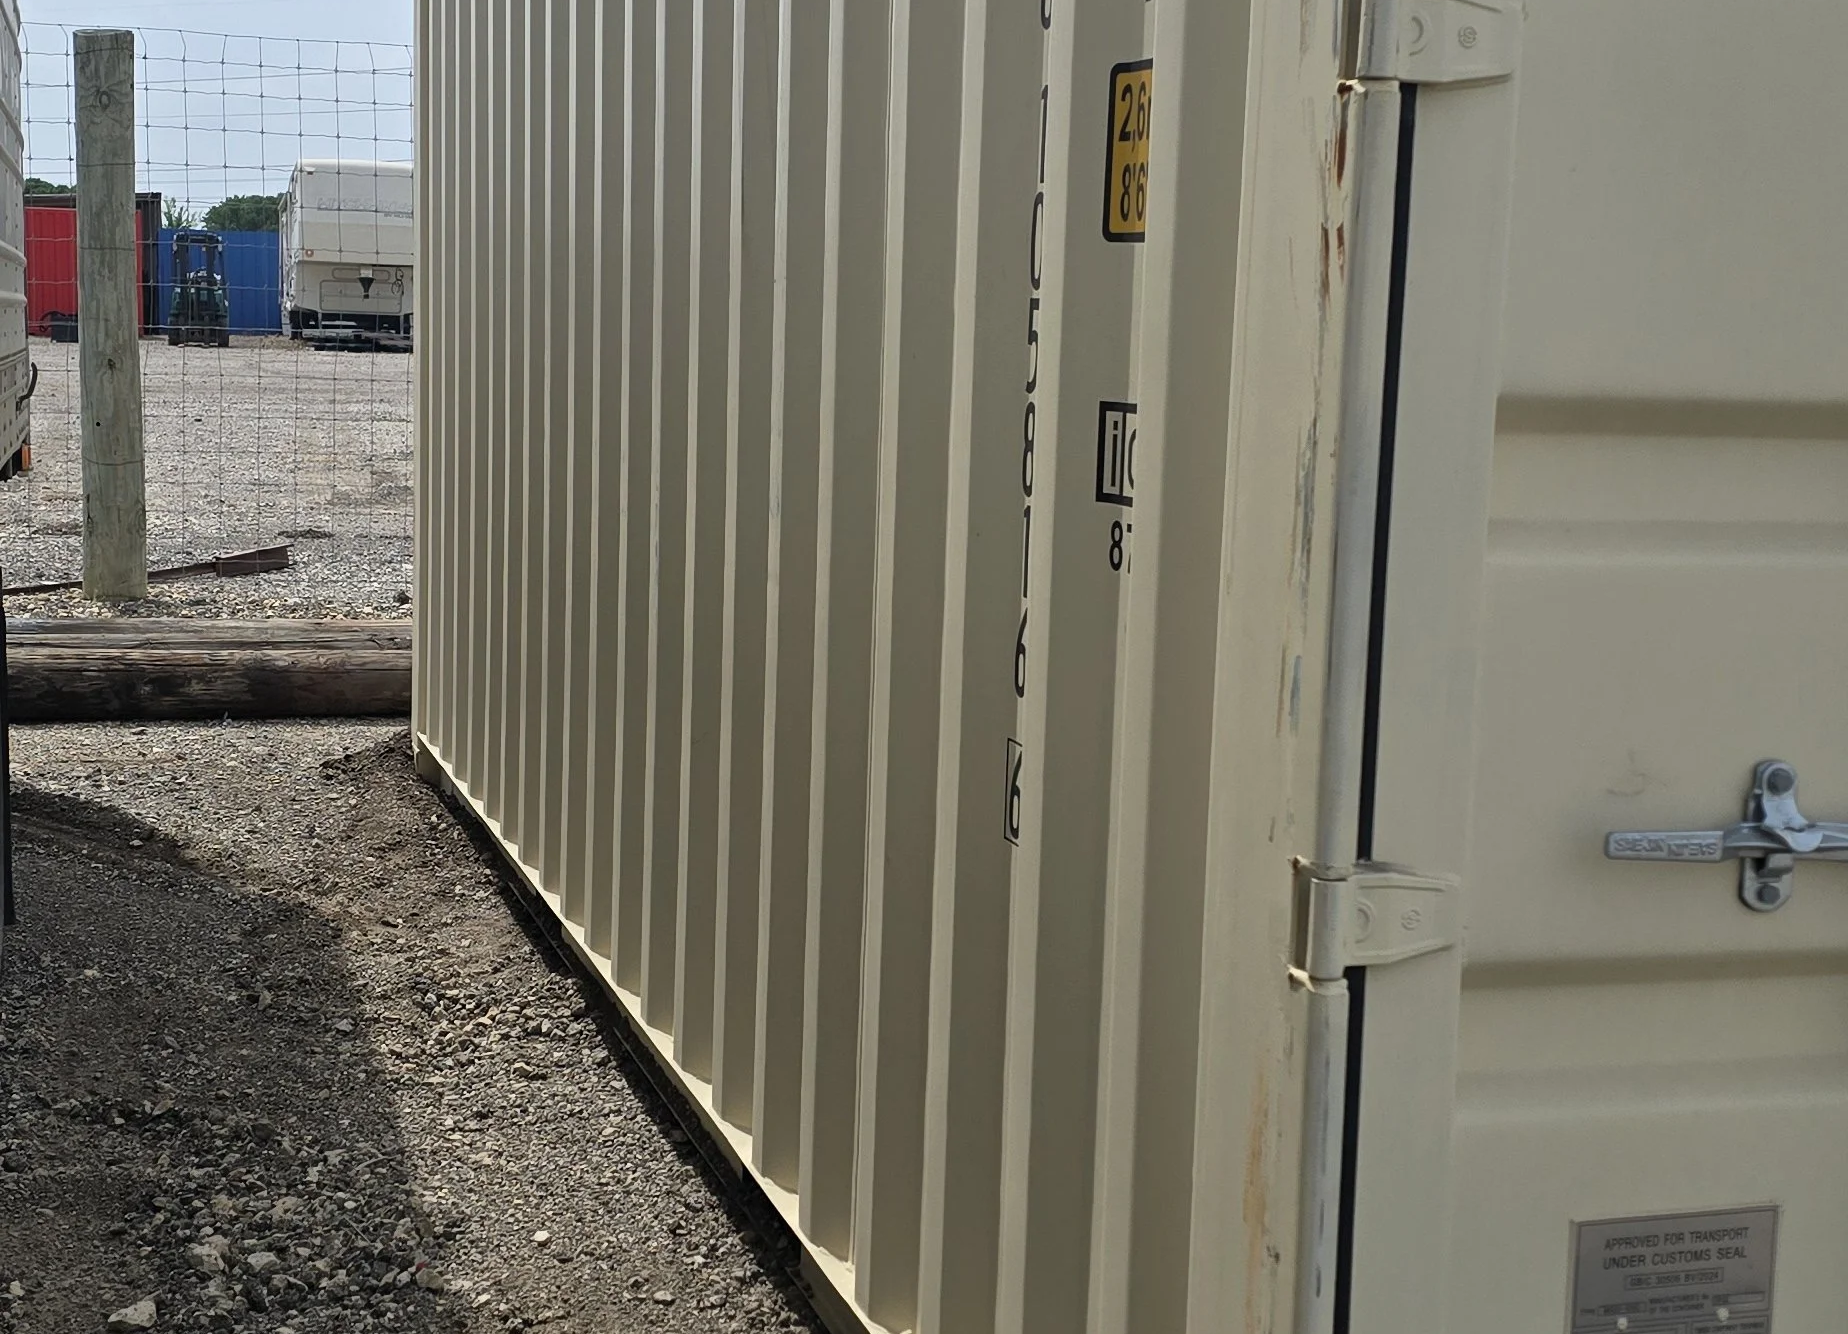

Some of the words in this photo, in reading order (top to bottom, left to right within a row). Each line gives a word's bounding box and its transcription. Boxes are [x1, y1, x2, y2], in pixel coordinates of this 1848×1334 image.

[1118, 80, 1152, 153] 2,6
[1015, 84, 1048, 698] 105816
[1008, 750, 1022, 840] 6
[1603, 1254, 1646, 1270] UNDER
[1651, 1248, 1711, 1266] CUSTOMS
[1716, 1246, 1747, 1260] SEAL
[1604, 1234, 1660, 1251] APPROVED
[1664, 1232, 1685, 1246] FOR
[1690, 1227, 1750, 1243] TRANSPORT
